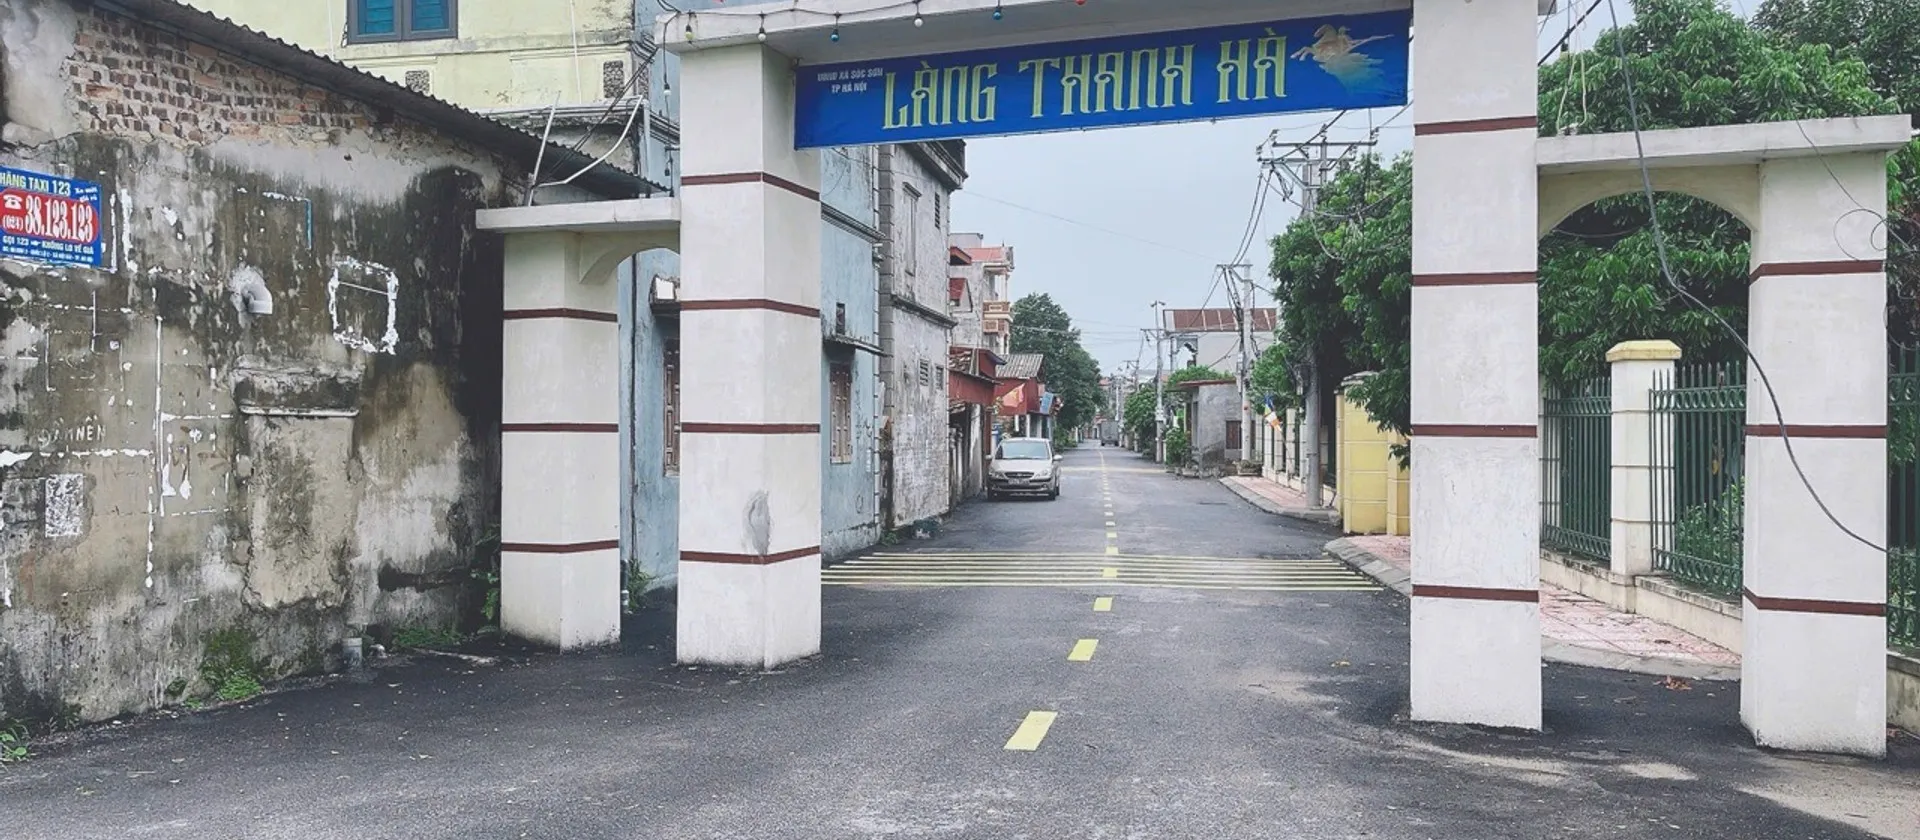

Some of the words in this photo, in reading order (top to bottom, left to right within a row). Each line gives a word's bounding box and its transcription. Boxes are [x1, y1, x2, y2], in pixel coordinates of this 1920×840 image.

[831, 83, 841, 94] TP
[882, 59, 997, 131] LÀNG
[1019, 44, 1195, 119] THANH
[1217, 27, 1288, 104] HÀ
[28, 177, 49, 193] TAXI
[52, 180, 71, 197] 123
[25, 195, 93, 243] 38.123.123
